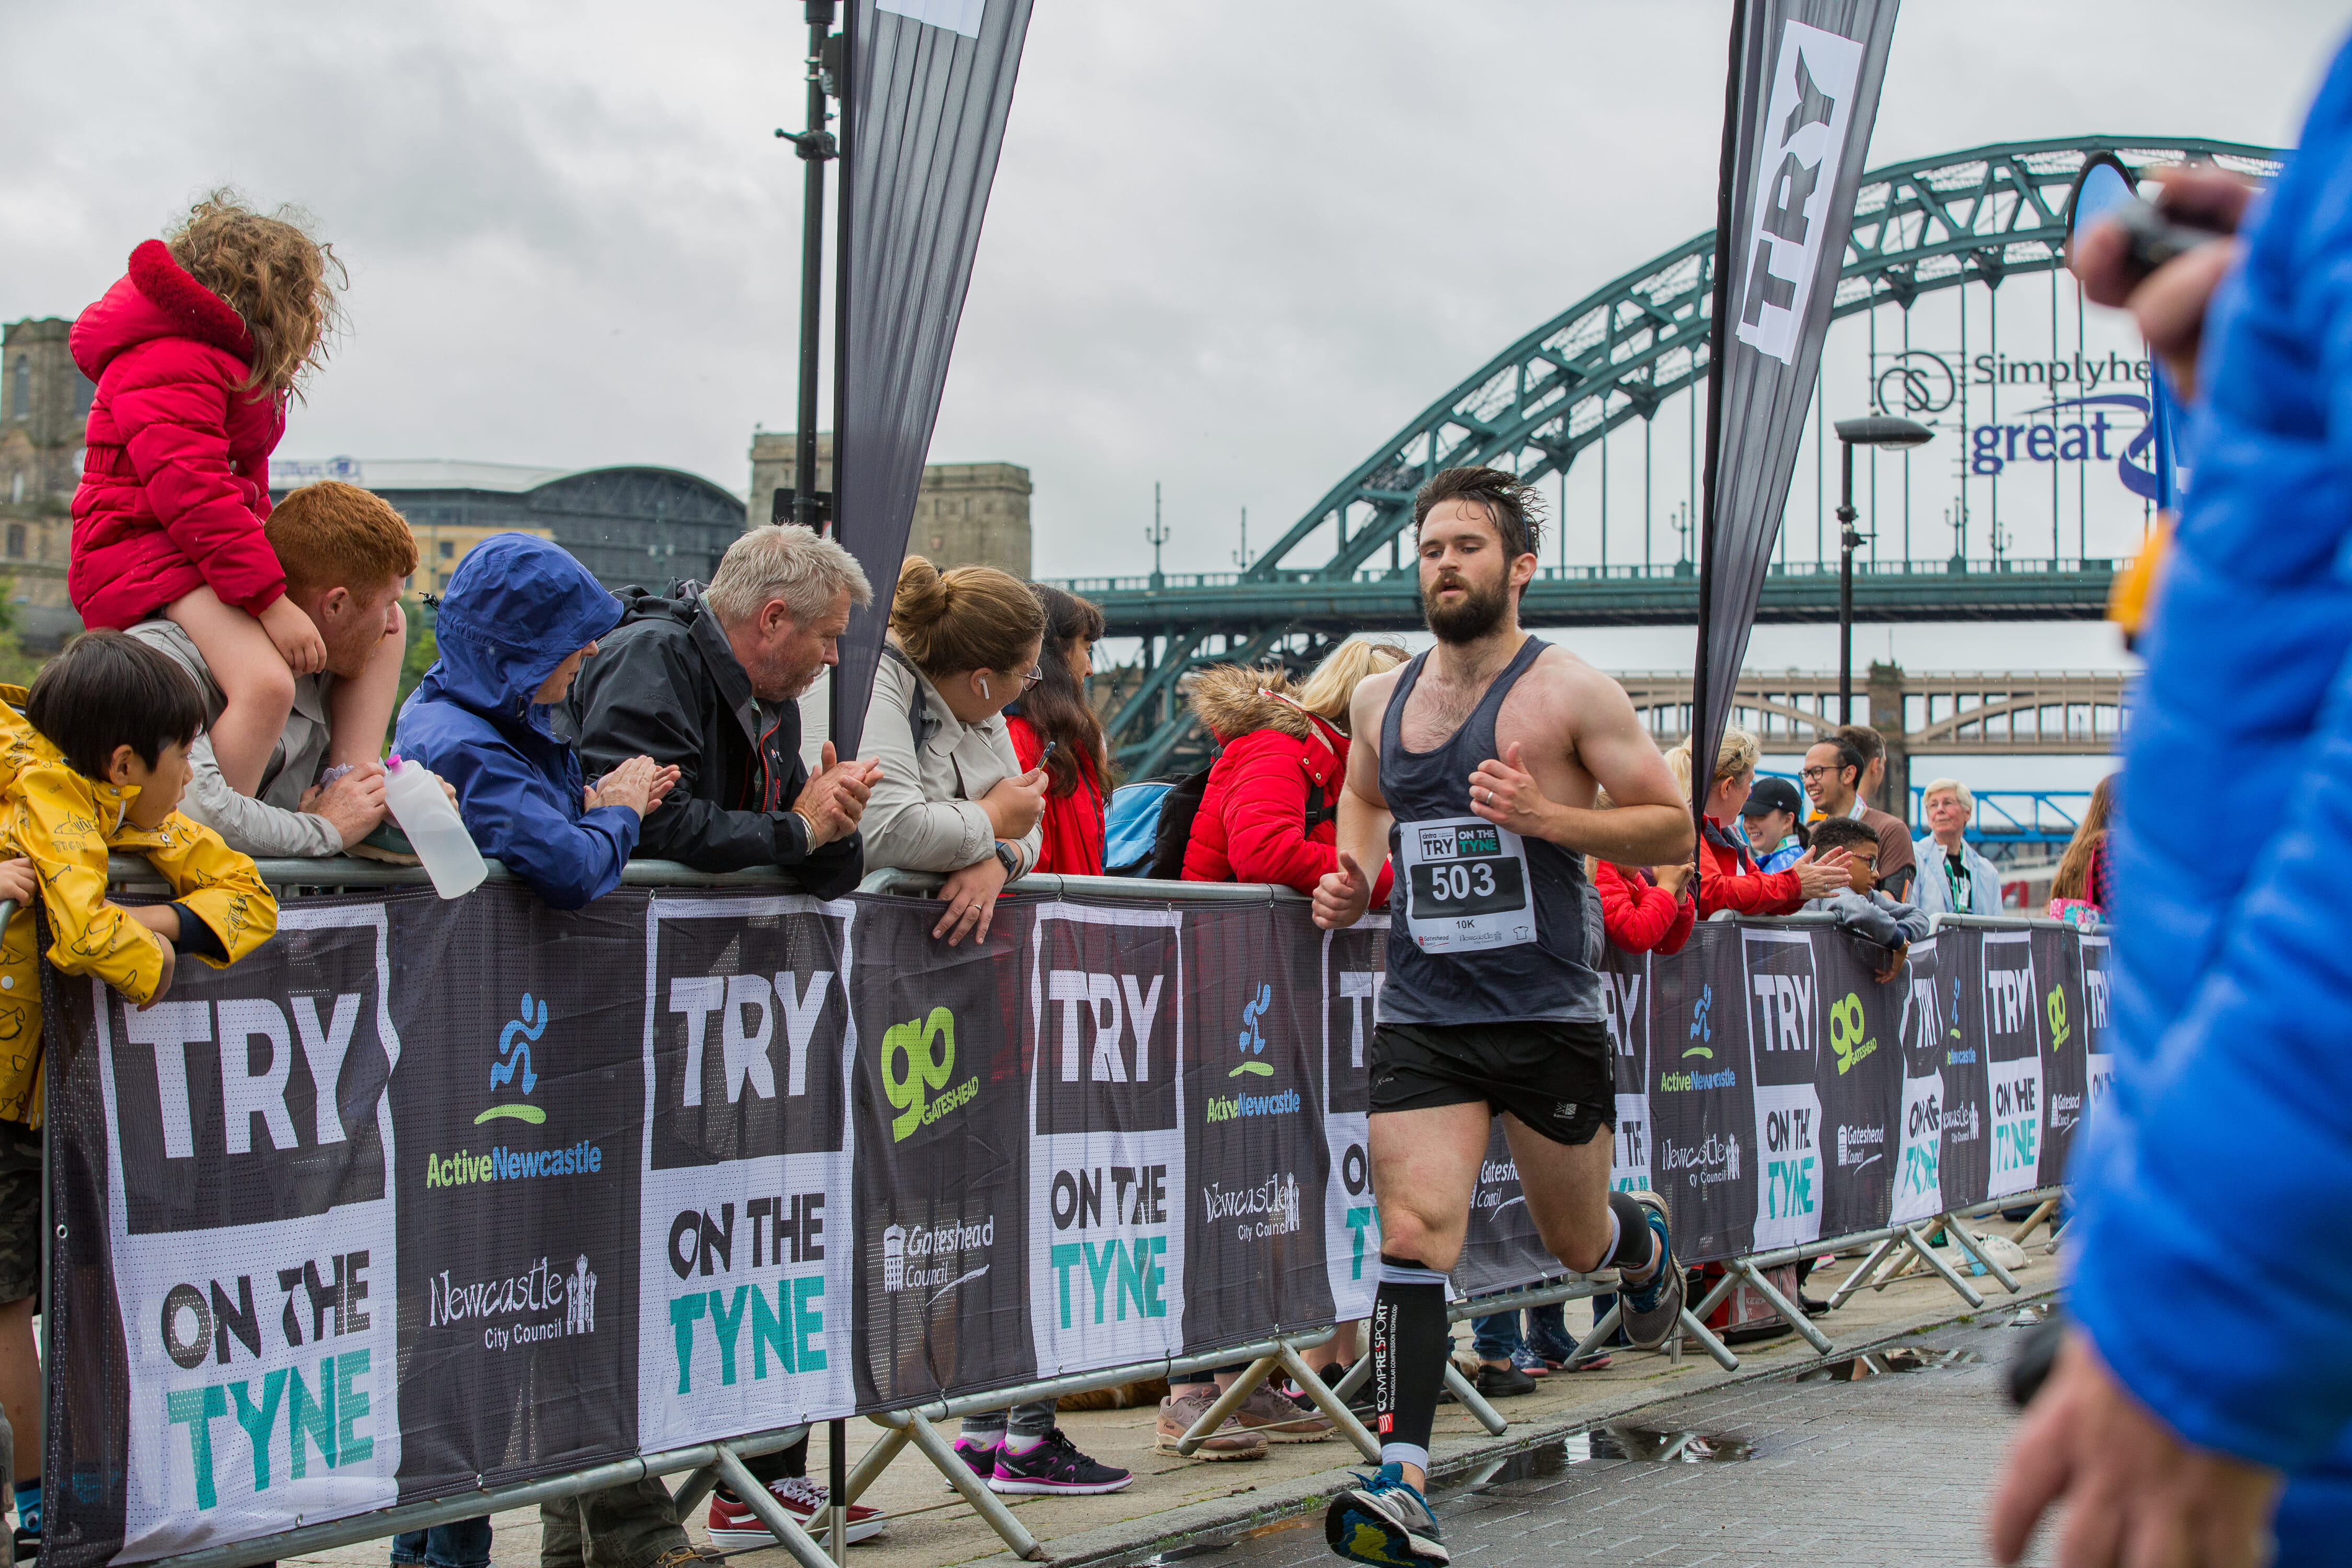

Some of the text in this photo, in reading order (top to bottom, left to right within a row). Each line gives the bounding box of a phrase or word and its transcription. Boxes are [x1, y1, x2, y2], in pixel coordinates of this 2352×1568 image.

[1742, 45, 1835, 328] TRY
[1972, 411, 2111, 475] great
[1423, 838, 1454, 856] TRY
[1458, 830, 1474, 840] ON
[1477, 829, 1495, 838] THE
[1458, 838, 1497, 852] TYNE
[1432, 863, 1496, 901] 503
[1456, 919, 1475, 929] 10K
[1050, 970, 1164, 1082] TRY
[1597, 971, 1641, 1056] RY
[1754, 974, 1811, 1051] TRY
[1988, 969, 2029, 1034] TRY
[668, 971, 835, 1106] TRY
[1830, 992, 1865, 1076] go
[1851, 1037, 1877, 1066] GATESHEAD
[124, 993, 362, 1158] TRY
[881, 1006, 954, 1143] go
[1996, 1082, 2011, 1117] ON
[921, 1076, 979, 1125] GATESHEAD
[1767, 1110, 1790, 1152] ON
[1848, 1123, 1884, 1145] Gateshead
[426, 1139, 602, 1189] ActiveNewcastle
[1342, 1143, 1374, 1196] O
[1700, 1169, 1726, 1184] Council
[1847, 1148, 1864, 1165] Council
[1051, 1165, 1167, 1230] ON THE
[1478, 1187, 1502, 1207] Council
[1768, 1156, 1815, 1220] TYNE
[668, 1193, 825, 1281] ON THE
[907, 1215, 994, 1256] Gateshead
[1238, 1224, 1252, 1242] City
[430, 1256, 563, 1328] Newcastle
[906, 1260, 949, 1288] Council
[1052, 1236, 1167, 1329] TYNE
[161, 1250, 370, 1369] ON THE
[1390, 1304, 1399, 1333] TECHNOLOGY
[485, 1322, 562, 1351] City Council
[670, 1276, 828, 1395] TYNE
[167, 1348, 374, 1512] TYNE
[1006, 1462, 1027, 1476] karrimor
